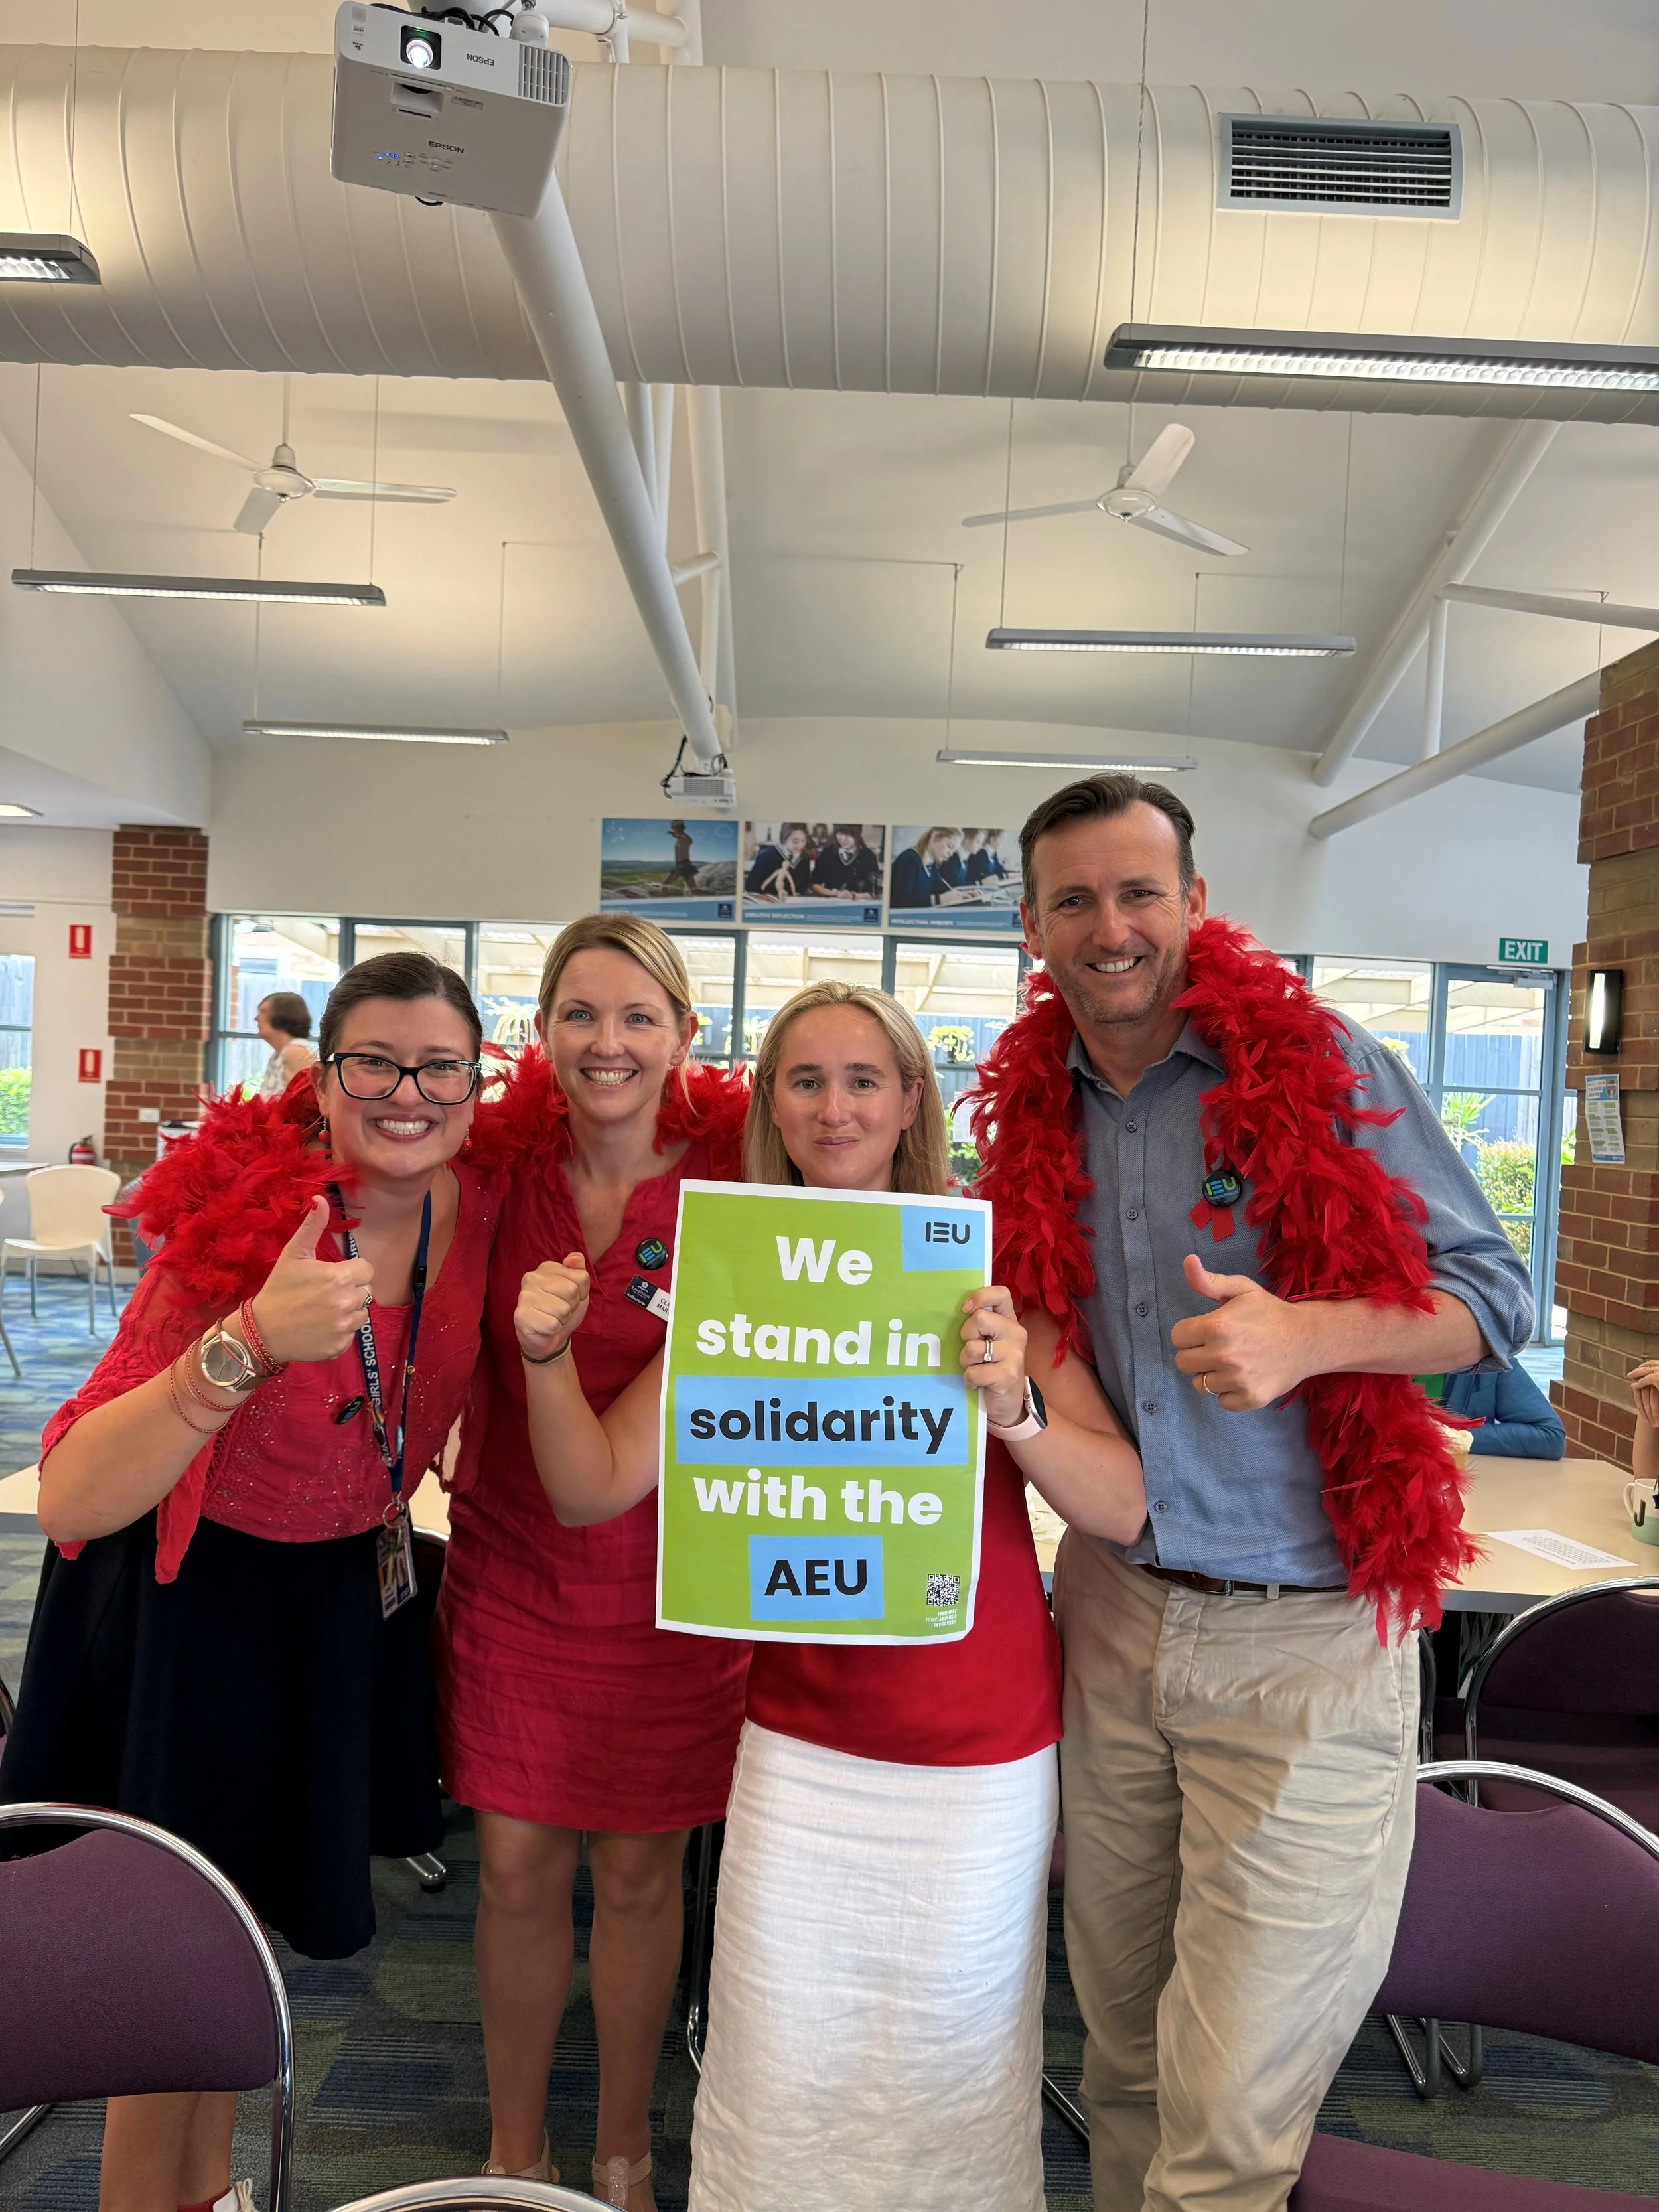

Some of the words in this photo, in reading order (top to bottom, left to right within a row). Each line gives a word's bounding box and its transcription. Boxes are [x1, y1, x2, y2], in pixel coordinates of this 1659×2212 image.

[467, 53, 495, 66] EPSON
[428, 141, 465, 153] EPSON
[1504, 940, 1543, 962] EXIT
[1206, 1176, 1237, 1196] IEU
[925, 1222, 970, 1244] IEU
[638, 1240, 663, 1263] IEU
[776, 1236, 873, 1286] We
[695, 1313, 873, 1365] stand
[886, 1318, 941, 1367] in
[690, 1396, 954, 1455] solidarity
[693, 1468, 826, 1520] with
[841, 1479, 943, 1526] the
[764, 1559, 867, 1596] AEU
